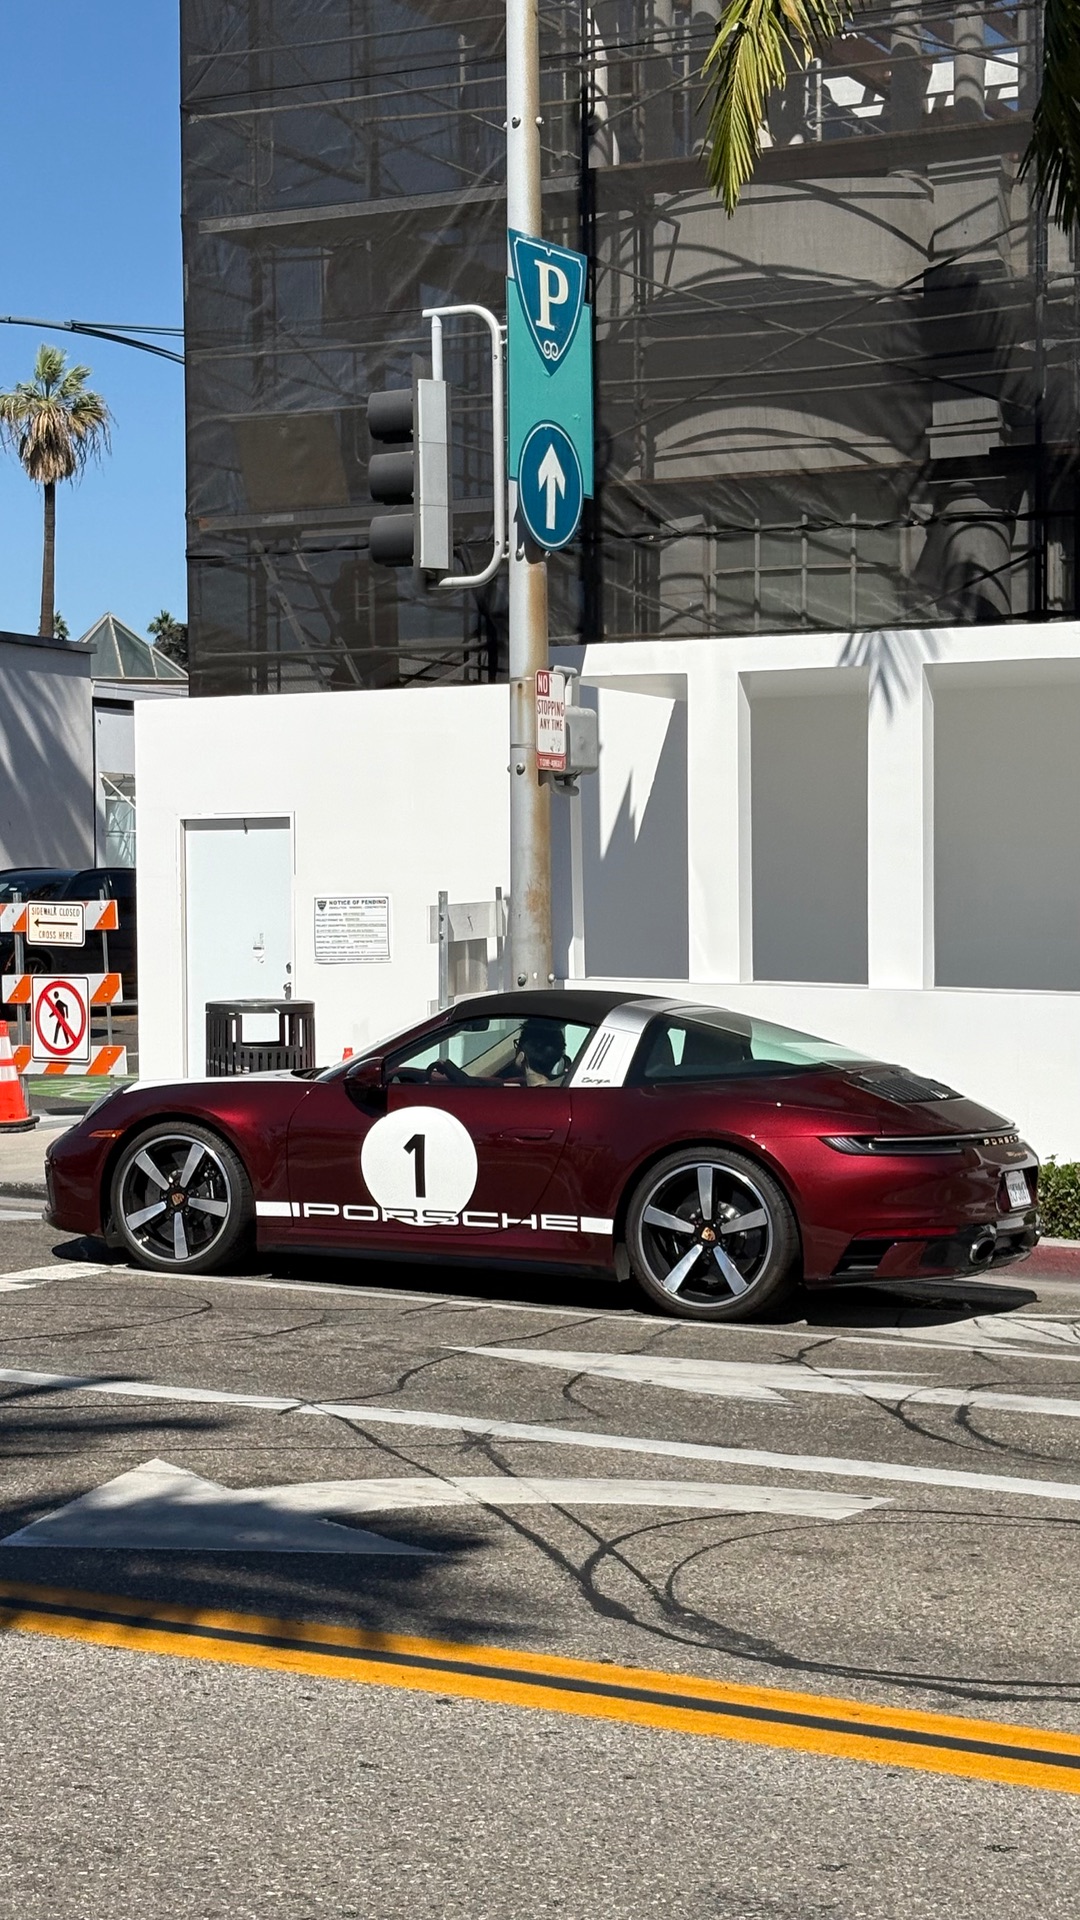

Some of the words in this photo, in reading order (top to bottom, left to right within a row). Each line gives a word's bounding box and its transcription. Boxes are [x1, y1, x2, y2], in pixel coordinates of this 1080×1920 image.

[534, 259, 569, 331] P
[537, 674, 548, 693] NO
[537, 699, 565, 717] STOPPING
[540, 718, 551, 730] ANY
[551, 719, 563, 731] TIME
[31, 907, 57, 916] SIDEWALK
[59, 908, 81, 917] CLOSED
[38, 931, 56, 940] CROSS
[58, 931, 73, 940] HERE
[403, 1133, 426, 1198] 1
[303, 1202, 579, 1232] PORSCHE
